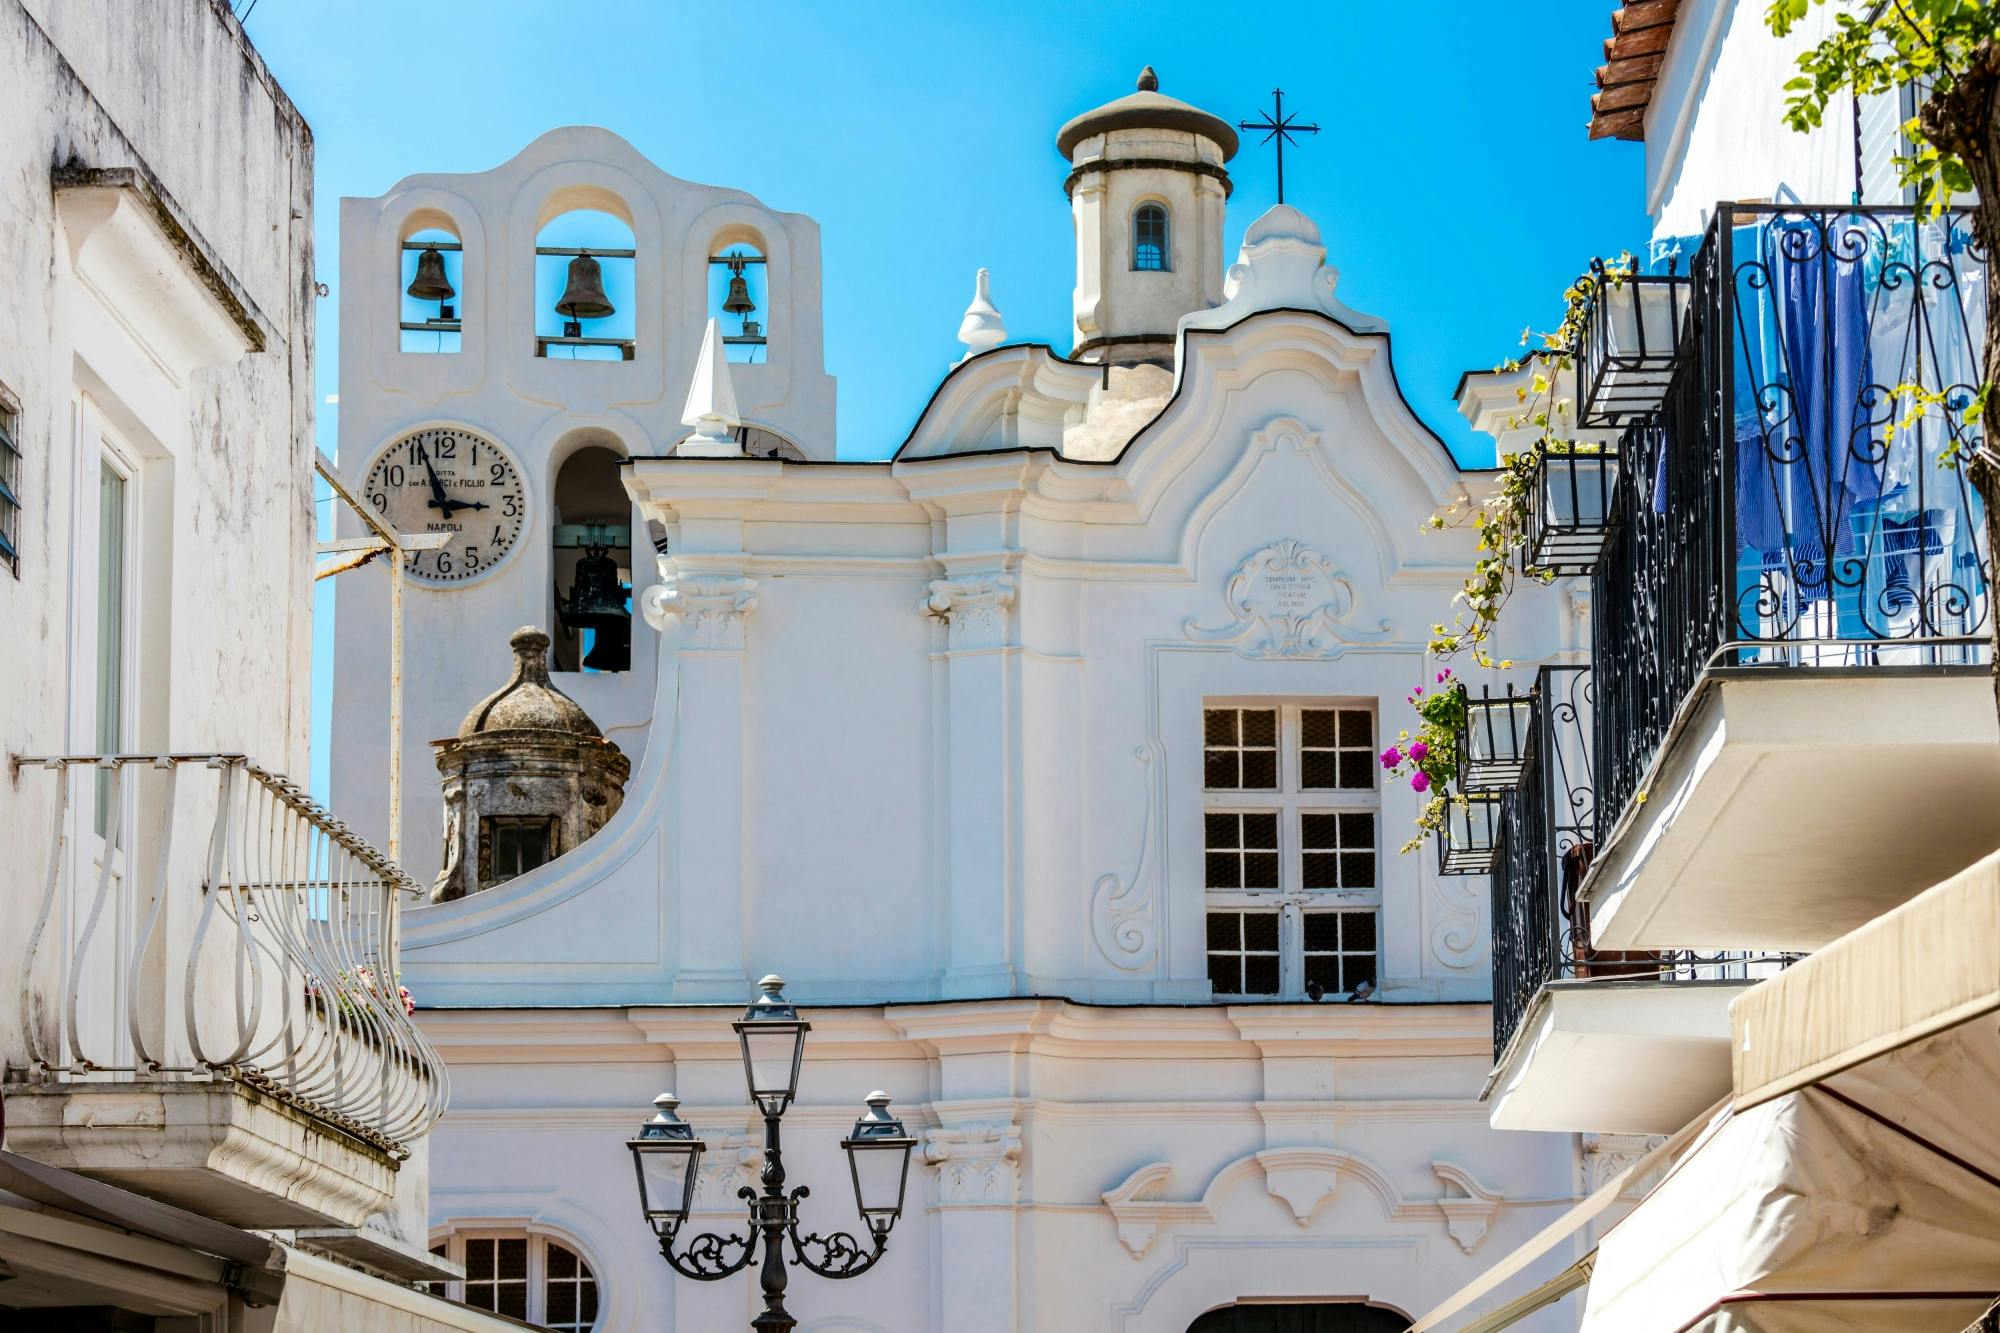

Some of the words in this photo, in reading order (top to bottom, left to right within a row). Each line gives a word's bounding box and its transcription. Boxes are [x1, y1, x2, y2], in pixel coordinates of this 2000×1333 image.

[409, 443, 423, 466] 11
[434, 437, 456, 459] 12
[471, 444, 478, 466] 1
[383, 464, 405, 487] 10
[459, 479, 485, 488] FIGLIO
[490, 464, 505, 486] 2
[372, 493, 388, 514] 9
[502, 495, 517, 517] 3
[427, 523, 463, 532] NAPOLI
[490, 525, 506, 547] 4
[437, 552, 452, 574] 6
[465, 547, 479, 569] 5
